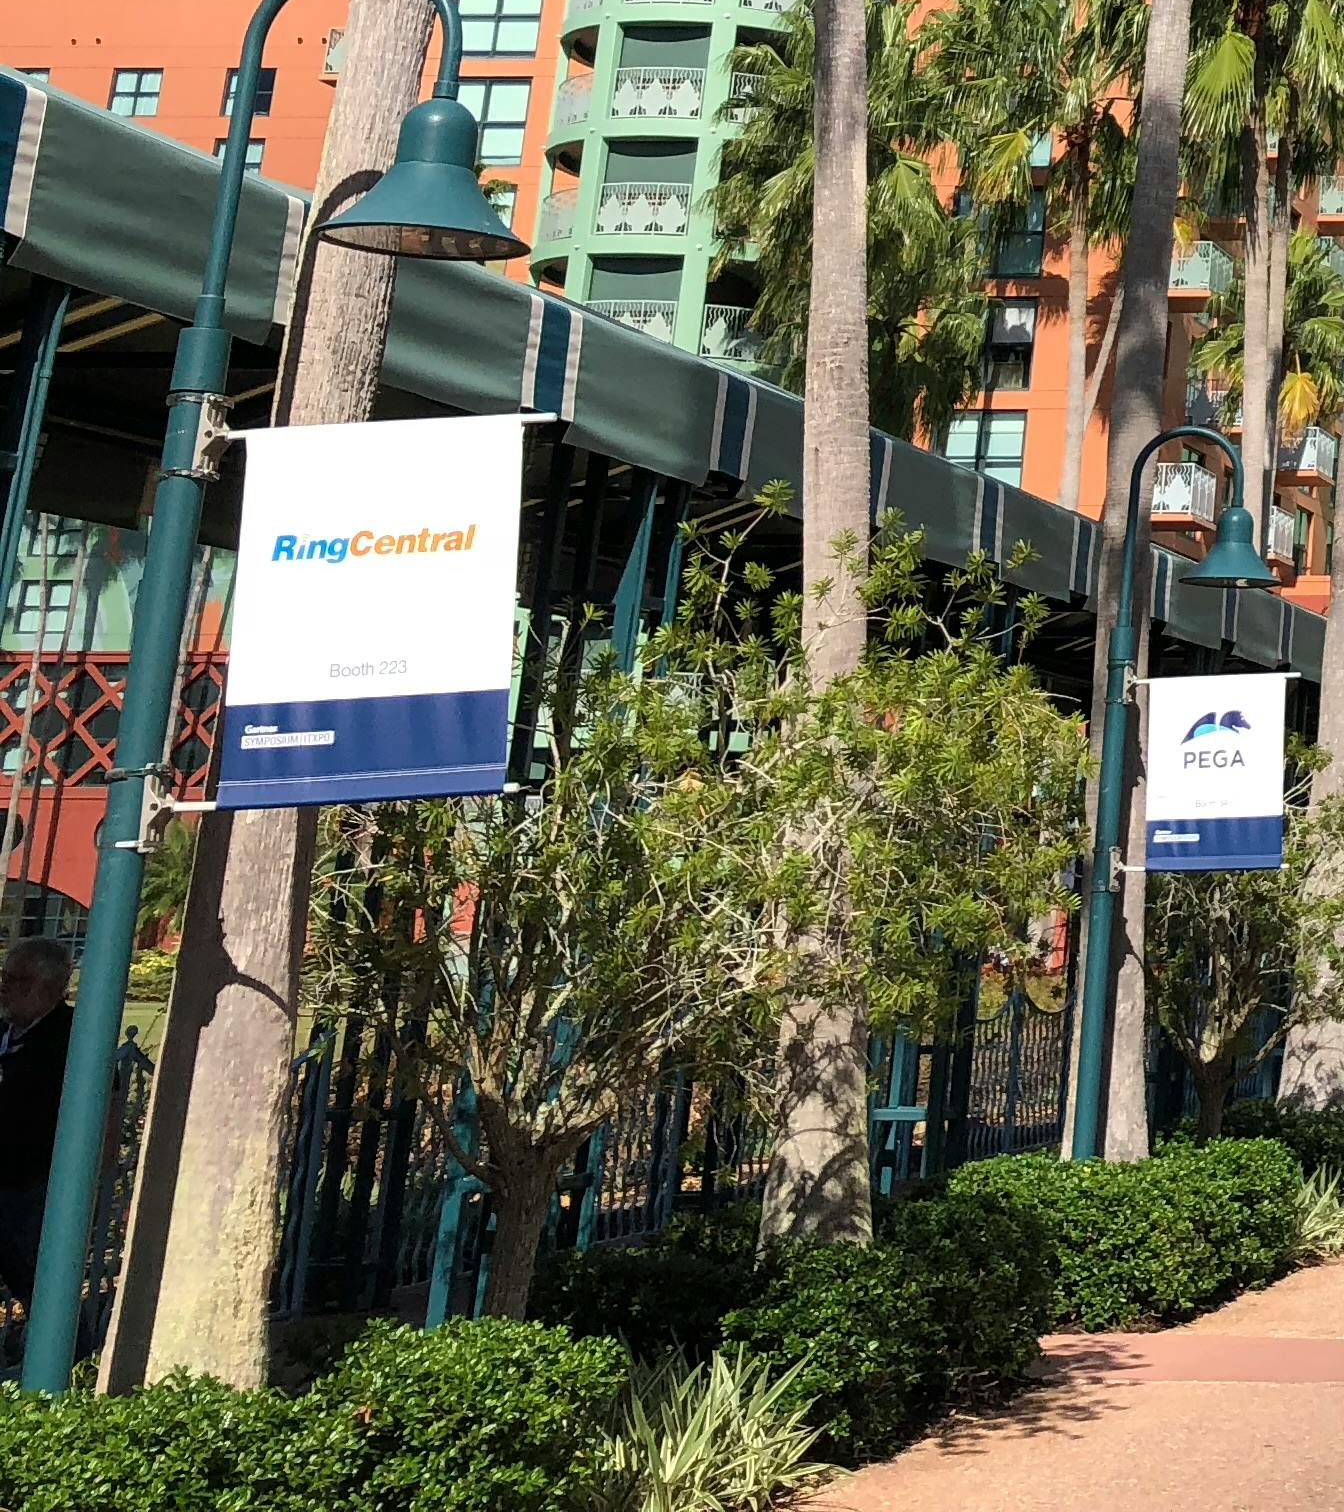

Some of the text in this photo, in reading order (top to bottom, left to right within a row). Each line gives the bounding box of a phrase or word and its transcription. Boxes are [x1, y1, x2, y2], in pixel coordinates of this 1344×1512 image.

[271, 524, 477, 564] RingCentral
[329, 659, 408, 678] Booth 223
[1183, 749, 1246, 769] PEGA
